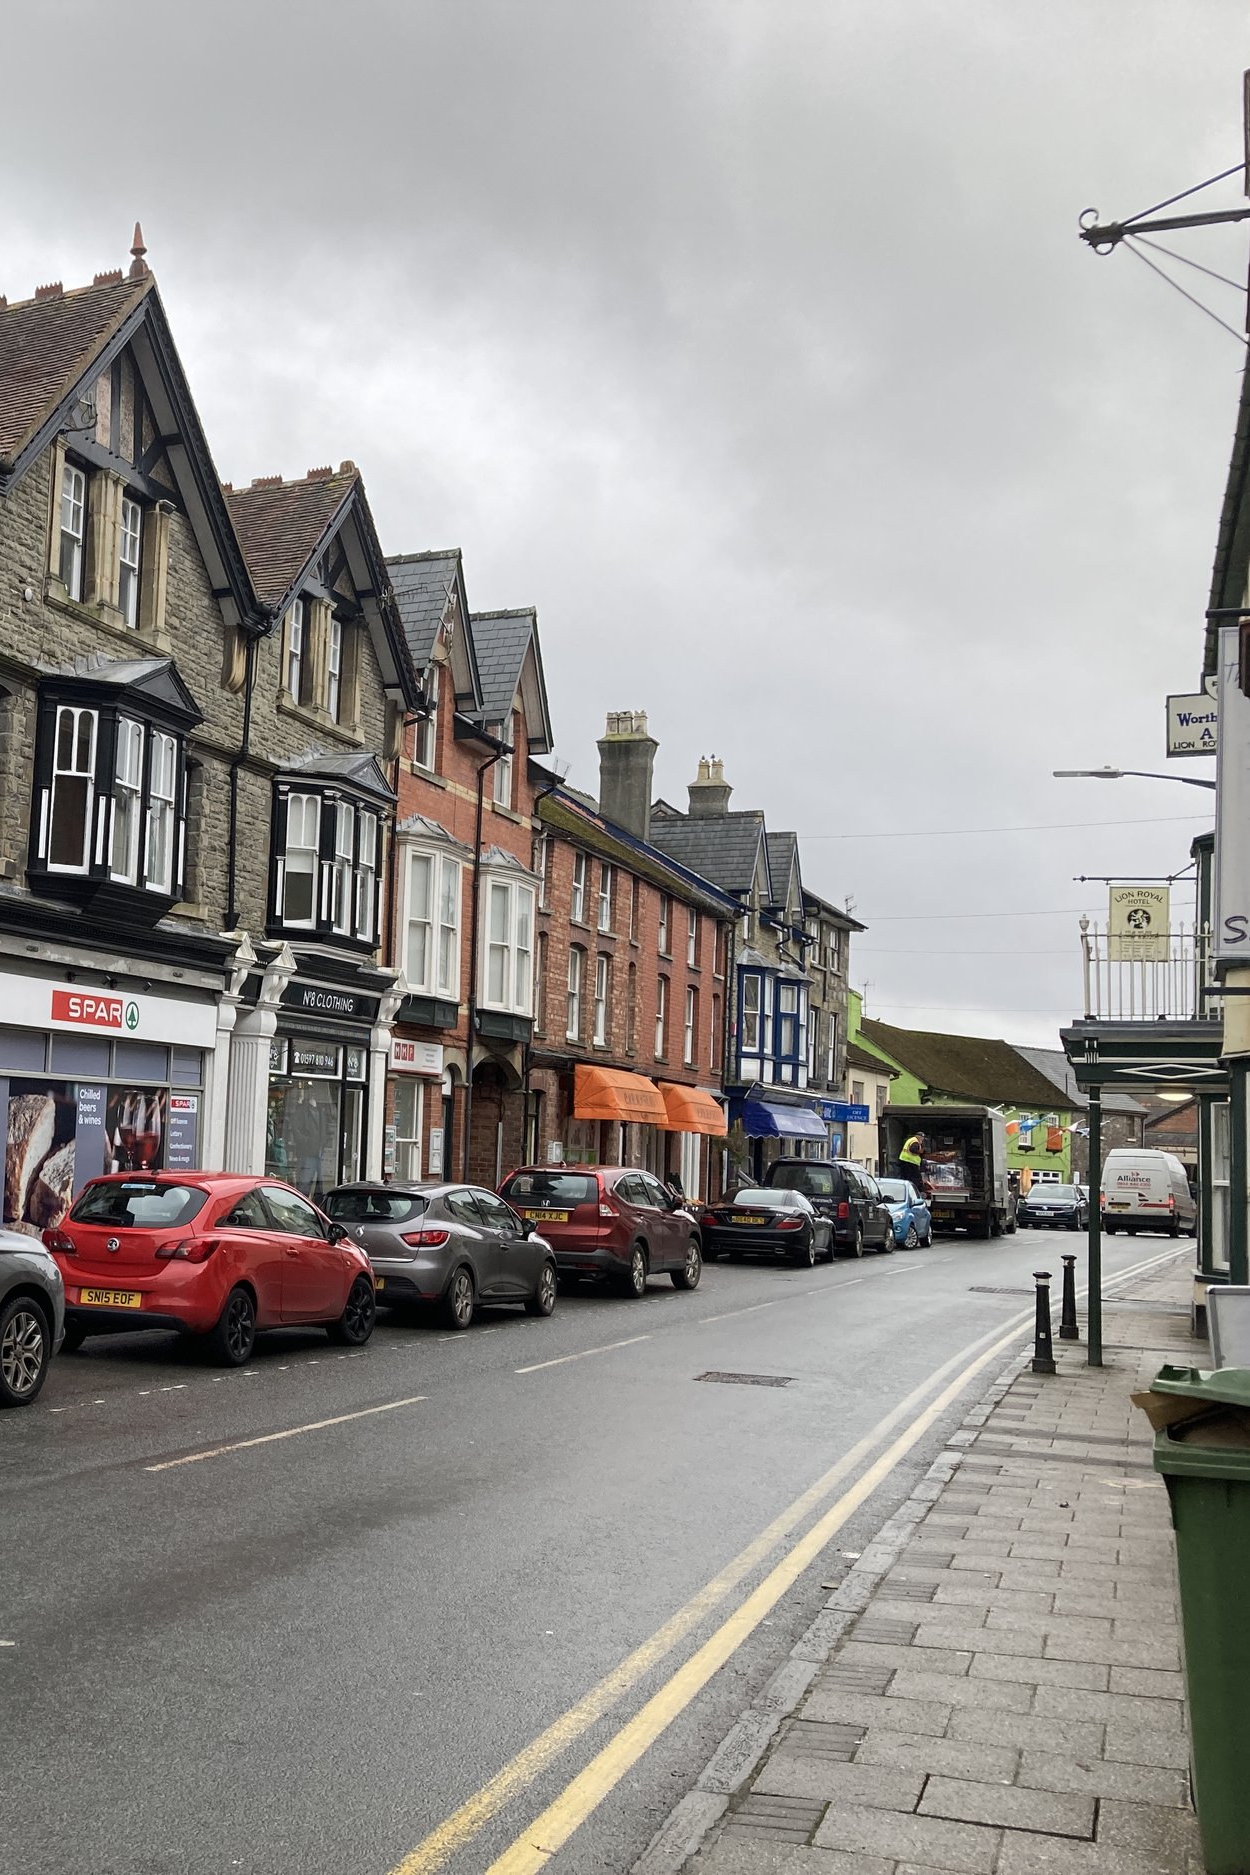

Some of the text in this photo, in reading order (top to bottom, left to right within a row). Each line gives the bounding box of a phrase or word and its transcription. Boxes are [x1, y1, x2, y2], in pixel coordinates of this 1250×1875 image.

[1174, 740, 1217, 750] LION RO
[1114, 890, 1164, 904] LION ROYAL
[316, 994, 354, 1012] CLOTHING
[68, 997, 122, 1023] SPAR
[300, 1053, 315, 1065] 01597
[324, 1056, 334, 1067] 946
[79, 1088, 100, 1100] Chilled
[78, 1101, 96, 1112] beers
[175, 1100, 190, 1108] SPAR
[78, 1114, 102, 1125] & wines
[88, 1291, 135, 1305] SN15 EOF
